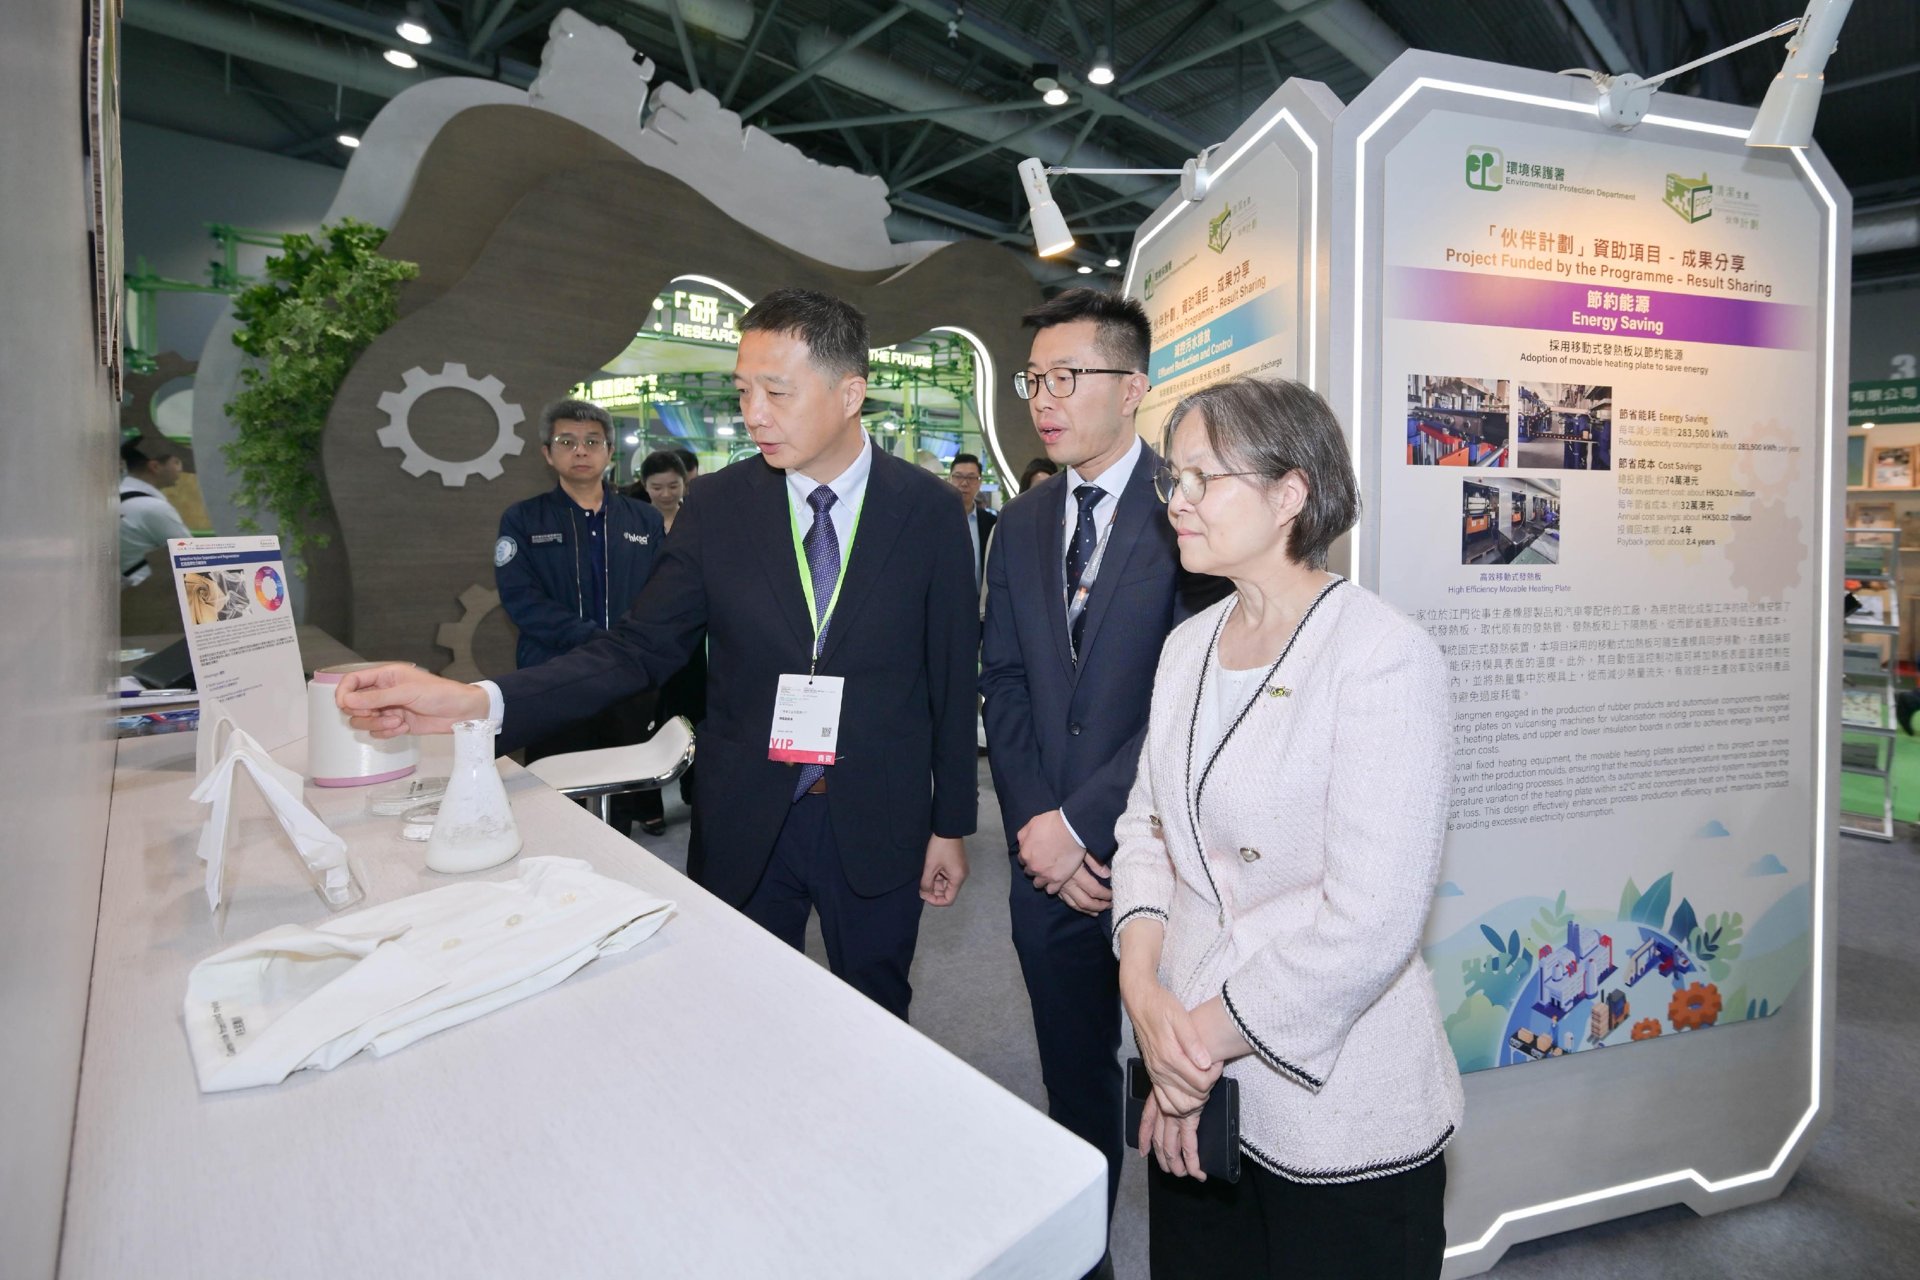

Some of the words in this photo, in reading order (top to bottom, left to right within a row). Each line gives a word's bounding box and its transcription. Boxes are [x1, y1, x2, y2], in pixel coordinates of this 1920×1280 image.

[1506, 160, 1565, 182] 環境保護署
[1505, 176, 1558, 191] Environmental
[1559, 183, 1595, 196] Protection
[1596, 188, 1636, 201] Department
[1682, 249, 1746, 273] 成果分享
[1446, 248, 1497, 267] Project
[1501, 254, 1553, 271] Funded
[1556, 259, 1572, 277] by
[1576, 262, 1597, 275] the
[1600, 265, 1674, 284] Programme
[1686, 273, 1724, 290] Result
[1727, 278, 1772, 297] Sharing
[1240, 275, 1266, 298] Sharing
[1587, 290, 1650, 314] 節約能源
[1572, 311, 1618, 331] Energy
[1620, 315, 1664, 335] Saving
[673, 322, 742, 344] RESEARC
[891, 352, 932, 369] FUTURE
[1520, 353, 1558, 365] Adoption
[1559, 355, 1568, 364] of
[1569, 357, 1603, 367] movable
[1604, 359, 1633, 371] heating
[1635, 361, 1654, 372] plate
[1655, 363, 1663, 371] to
[1683, 365, 1709, 376] energy
[1619, 408, 1657, 422] 節省能耗
[1659, 412, 1684, 424] Energy
[1685, 414, 1709, 425] Saving
[1711, 428, 1729, 439] kWh
[1618, 457, 1656, 470] 節省成本
[1658, 460, 1675, 470] Cost
[1675, 462, 1702, 473] Savings
[1617, 487, 1634, 496] Total
[1617, 512, 1641, 521] Annual
[1447, 586, 1465, 595] High
[1465, 585, 1498, 595] Efficiency
[1499, 584, 1527, 593] Movable
[1528, 584, 1554, 593] Heating
[1495, 710, 1529, 719] engaged
[1541, 707, 1553, 715] the
[1556, 705, 1595, 714] production
[1607, 702, 1631, 711] rubber
[1633, 701, 1664, 710] products
[1475, 722, 1498, 732] plates
[1515, 720, 1556, 728] vulcanising
[1560, 716, 1595, 725] machines
[1598, 715, 1607, 723] for
[1463, 735, 1493, 744] heating
[1522, 731, 1537, 739] and
[1540, 731, 1561, 739] upper
[1564, 728, 1578, 736] and
[1581, 727, 1600, 735] lower
[1603, 724, 1637, 733] insulation
[1639, 722, 1663, 731] boards
[770, 738, 794, 750] VIP
[1476, 760, 1494, 768] fixed
[1499, 759, 1526, 767] heating
[1590, 751, 1621, 760] movable
[1463, 773, 1479, 781] with
[1481, 772, 1493, 780] the
[1495, 769, 1536, 779] production
[1568, 765, 1600, 773] ensuring
[1468, 785, 1483, 793] and
[1485, 782, 1523, 792] unloading
[1567, 776, 1573, 785] In
[1484, 806, 1500, 815] This
[1504, 805, 1529, 814] design
[1533, 801, 1569, 811] effectively
[1572, 798, 1607, 807] enhances
[1610, 795, 1638, 804] process
[1641, 791, 1678, 801] production
[1485, 795, 1519, 804] variation
[1521, 792, 1528, 800] of
[1531, 791, 1543, 799] the
[1545, 790, 1572, 798] heating
[1574, 787, 1592, 796] plate
[1595, 785, 1616, 793] within
[1456, 820, 1489, 830] avoiding
[1491, 817, 1527, 826] excessive
[1529, 812, 1564, 823] electricity
